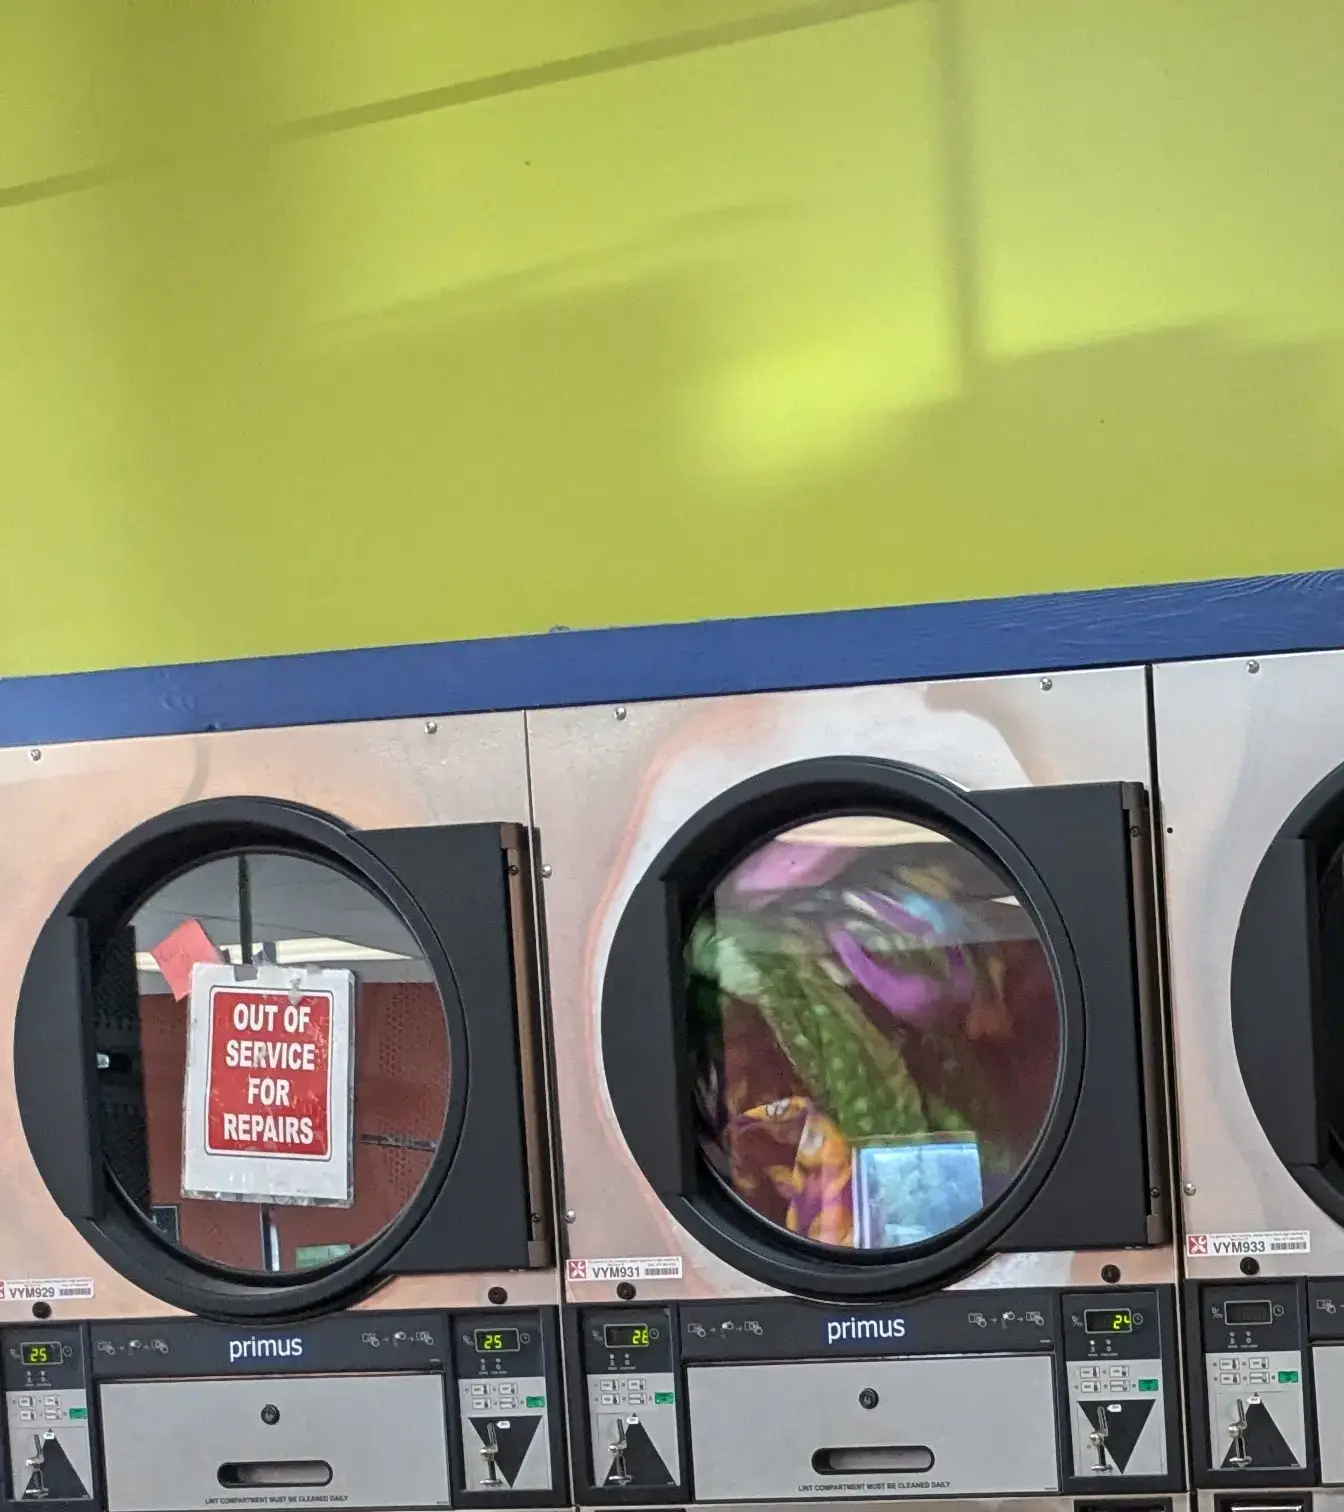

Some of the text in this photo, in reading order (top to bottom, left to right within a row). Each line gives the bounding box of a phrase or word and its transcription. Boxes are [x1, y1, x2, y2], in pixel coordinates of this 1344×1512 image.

[233, 1003, 310, 1033] OUT OF
[226, 1040, 315, 1070] SERVICE
[248, 1077, 289, 1106] FOR
[224, 1113, 313, 1144] REPAIRS
[1213, 1241, 1265, 1254] VYM933
[592, 1266, 640, 1278] VYM931
[10, 1287, 55, 1298] VYM929
[484, 1334, 503, 1349] 25
[827, 1316, 906, 1344] primus
[30, 1347, 48, 1362] 25
[229, 1334, 303, 1363] primus
